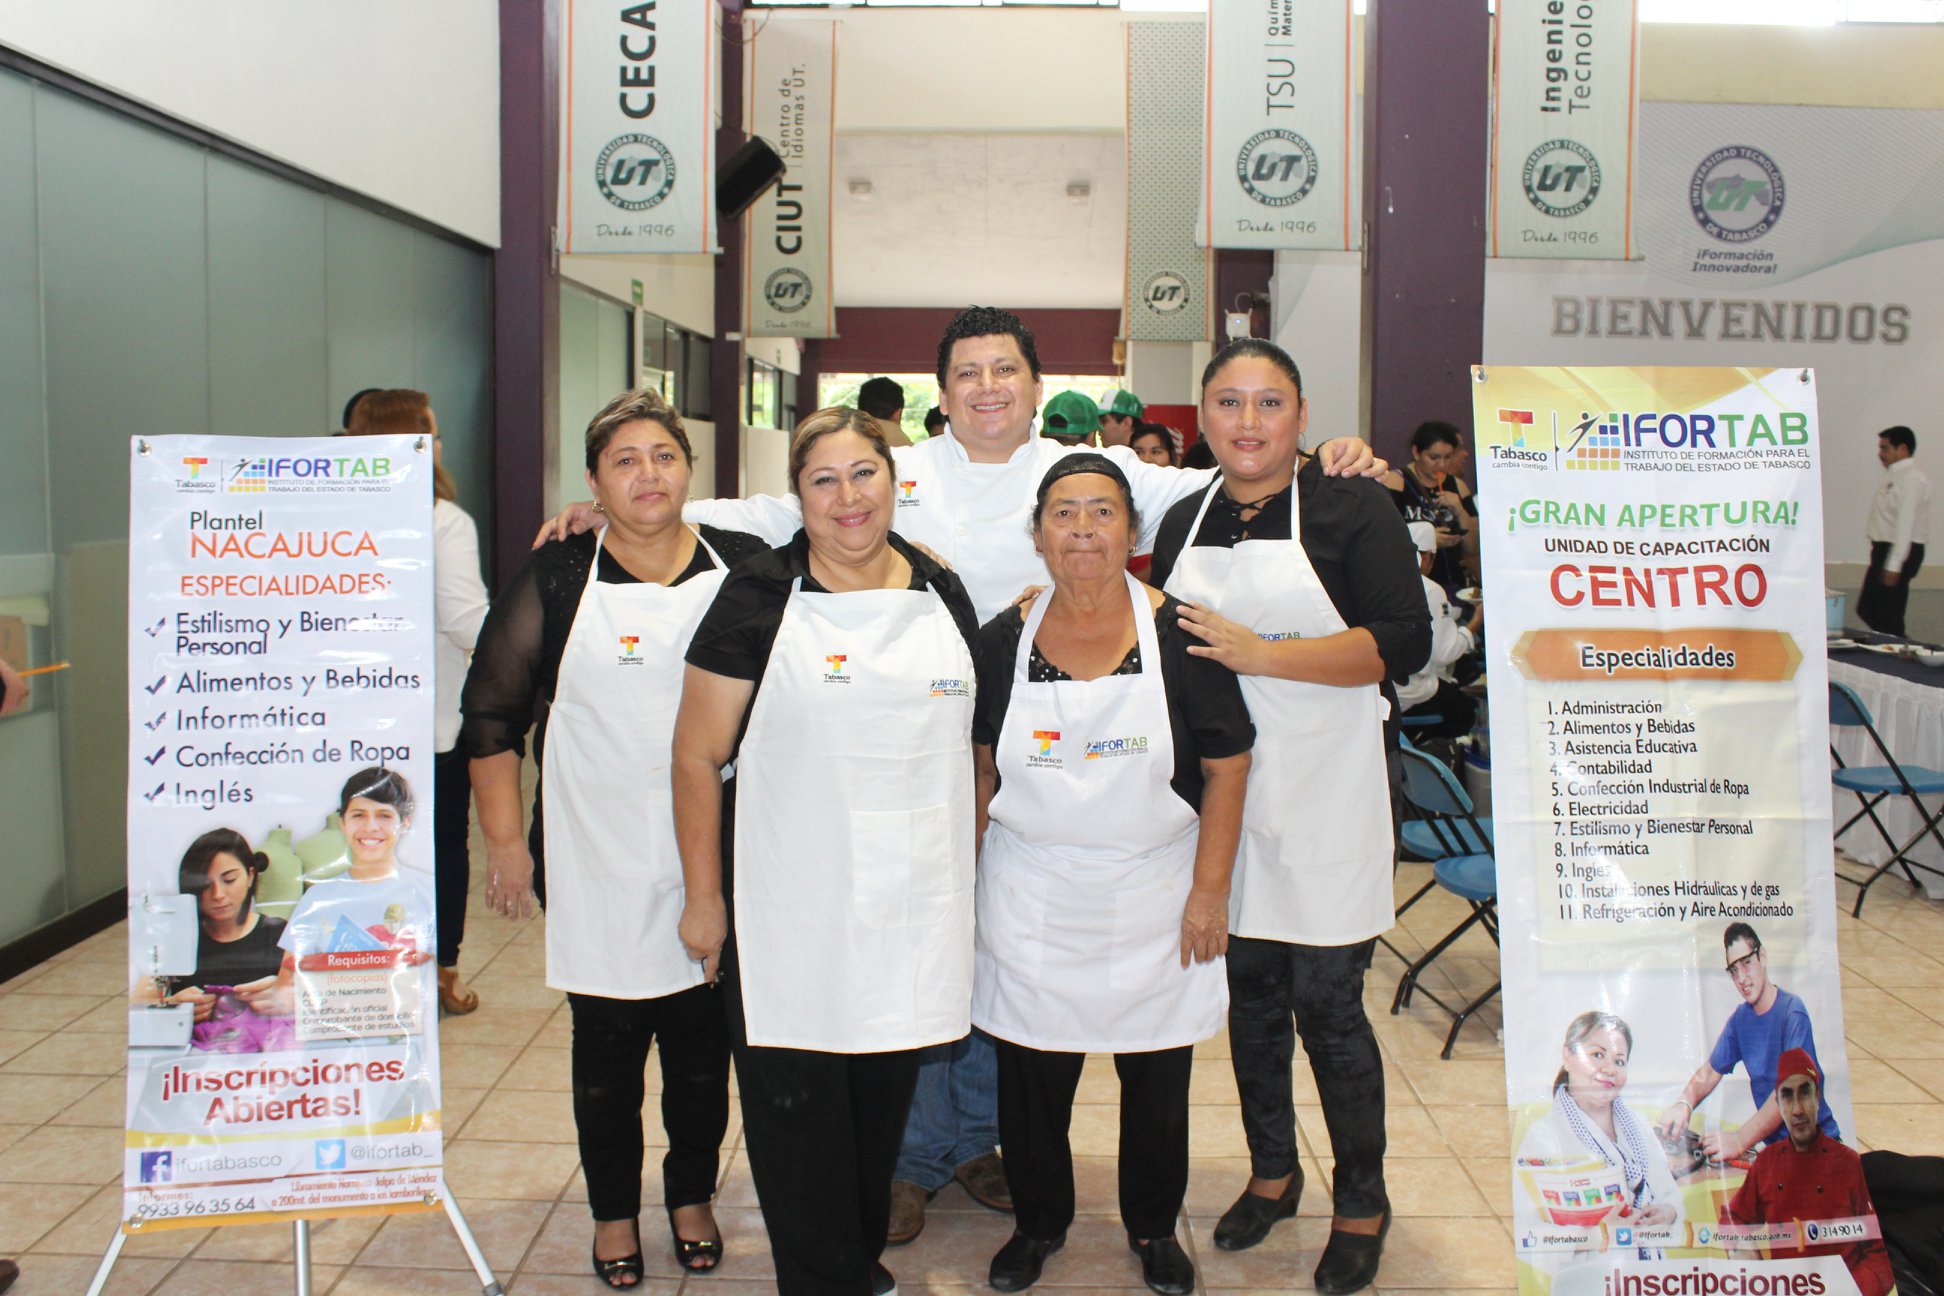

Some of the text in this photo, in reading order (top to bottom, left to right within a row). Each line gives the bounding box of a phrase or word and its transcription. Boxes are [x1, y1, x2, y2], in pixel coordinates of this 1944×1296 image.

[619, 2, 656, 119] CECA
[1540, 0, 1568, 112] Ingenie
[1569, 0, 1593, 114] Tecnolo
[1266, 58, 1296, 116] TSU
[777, 78, 791, 158] Centro de
[791, 64, 806, 158] Idiomas UT.
[609, 158, 662, 186] UT
[1251, 153, 1303, 182] UT
[1692, 148, 1737, 206] UNIVERSIDAD
[1536, 164, 1586, 192] UT
[1264, 192, 1303, 206] TABASCO
[775, 176, 803, 254] CIUT
[639, 224, 675, 237] 1996
[1280, 220, 1317, 233] 1996
[1706, 222, 1768, 240] DE TABASCO
[1563, 231, 1600, 244] 1996
[1692, 261, 1778, 274] Innovadora!
[773, 282, 803, 298] UT
[1151, 285, 1181, 302] UT
[1551, 295, 1911, 347] BIENVENIDOS
[1622, 412, 1809, 448] IFORTAB
[1489, 445, 1548, 462] Tabasco
[1623, 448, 1810, 460] INSTITUTO DE FORMACIÓN PARA EL
[267, 458, 391, 477] IFORTAB
[1492, 459, 1548, 471] cambia contigo
[1624, 460, 1811, 472] TRABAJO DEL ESTADO DE TABASCO
[175, 479, 216, 488] Tabasco
[189, 510, 263, 531] Plantel
[1508, 499, 1799, 532] ¡GRAN APERTURA!
[191, 530, 379, 559] NACAJUCA
[1544, 534, 1770, 556] UNIDAD DE CAPACITACIÓN
[1550, 563, 1767, 609] CENTRO
[176, 610, 292, 638] Estilismo y
[176, 633, 268, 656] Personal
[1581, 646, 1736, 673] Especialidades
[176, 667, 420, 696] Alimentos y Bebidas
[1548, 700, 1662, 715] 1. Administración
[177, 706, 327, 731] Informática
[1547, 718, 1696, 738] 2. Alimentos y Bebidas
[176, 740, 411, 767] Confección de Ropa
[1098, 736, 1148, 752] IFORTAB
[1565, 740, 1632, 755] Asistencia
[1635, 739, 1697, 754] Educativa
[1027, 755, 1063, 764] Tabasco
[1567, 759, 1652, 775] Contabilidad
[176, 780, 254, 811] Inglés
[1551, 778, 1750, 799] 5. Confección Industrial de Ropa
[1552, 800, 1649, 816] 6. Electricidad
[1554, 819, 1754, 839] 7. Estilismo y Bienestar Personal
[1554, 840, 1650, 857] 8. Informática
[1555, 863, 1567, 878] 9.
[1674, 880, 1738, 896] Hidráulicas
[1740, 885, 1748, 900] y
[1751, 880, 1763, 896] de
[1765, 885, 1780, 900] gas
[1583, 902, 1675, 923] Refrigeración
[1679, 906, 1687, 921] y
[1690, 901, 1716, 917] Aire
[1718, 901, 1794, 917] Acondicionado
[328, 953, 391, 968] Requisitos:
[339, 987, 387, 996] Nacimiento
[203, 1088, 361, 1126] Abiertas!
[351, 1143, 434, 1160] @ifortab_
[176, 1154, 283, 1173] ifortabasco
[137, 1196, 256, 1218] 9933 96 35 64
[322, 1192, 369, 1204] monumento
[1604, 1265, 1826, 1296] ¡Inscripciones
